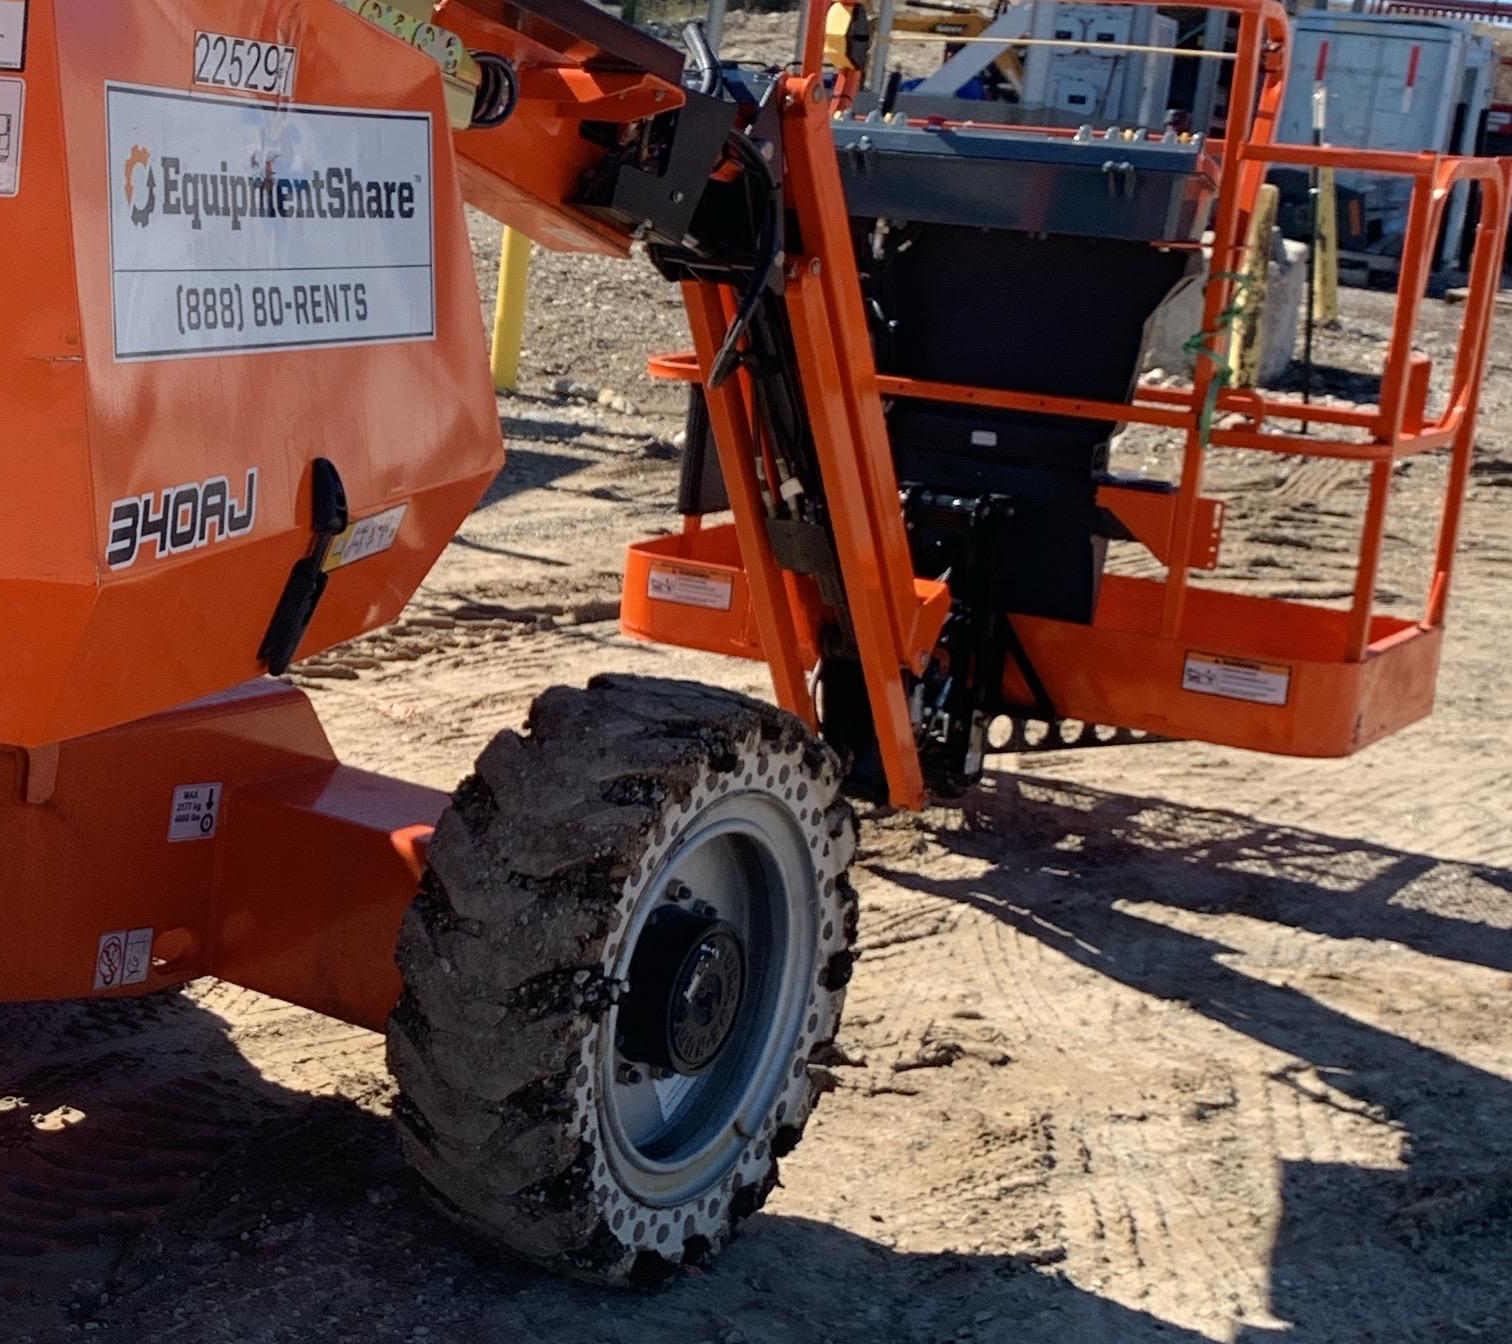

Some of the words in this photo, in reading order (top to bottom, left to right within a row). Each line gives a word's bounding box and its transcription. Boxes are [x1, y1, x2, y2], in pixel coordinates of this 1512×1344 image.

[194, 32, 295, 96] 225297
[160, 156, 416, 231] EquipmentShare
[176, 284, 244, 335] (888)
[252, 283, 369, 329] 80-RENTS
[107, 470, 257, 568] 340AJ
